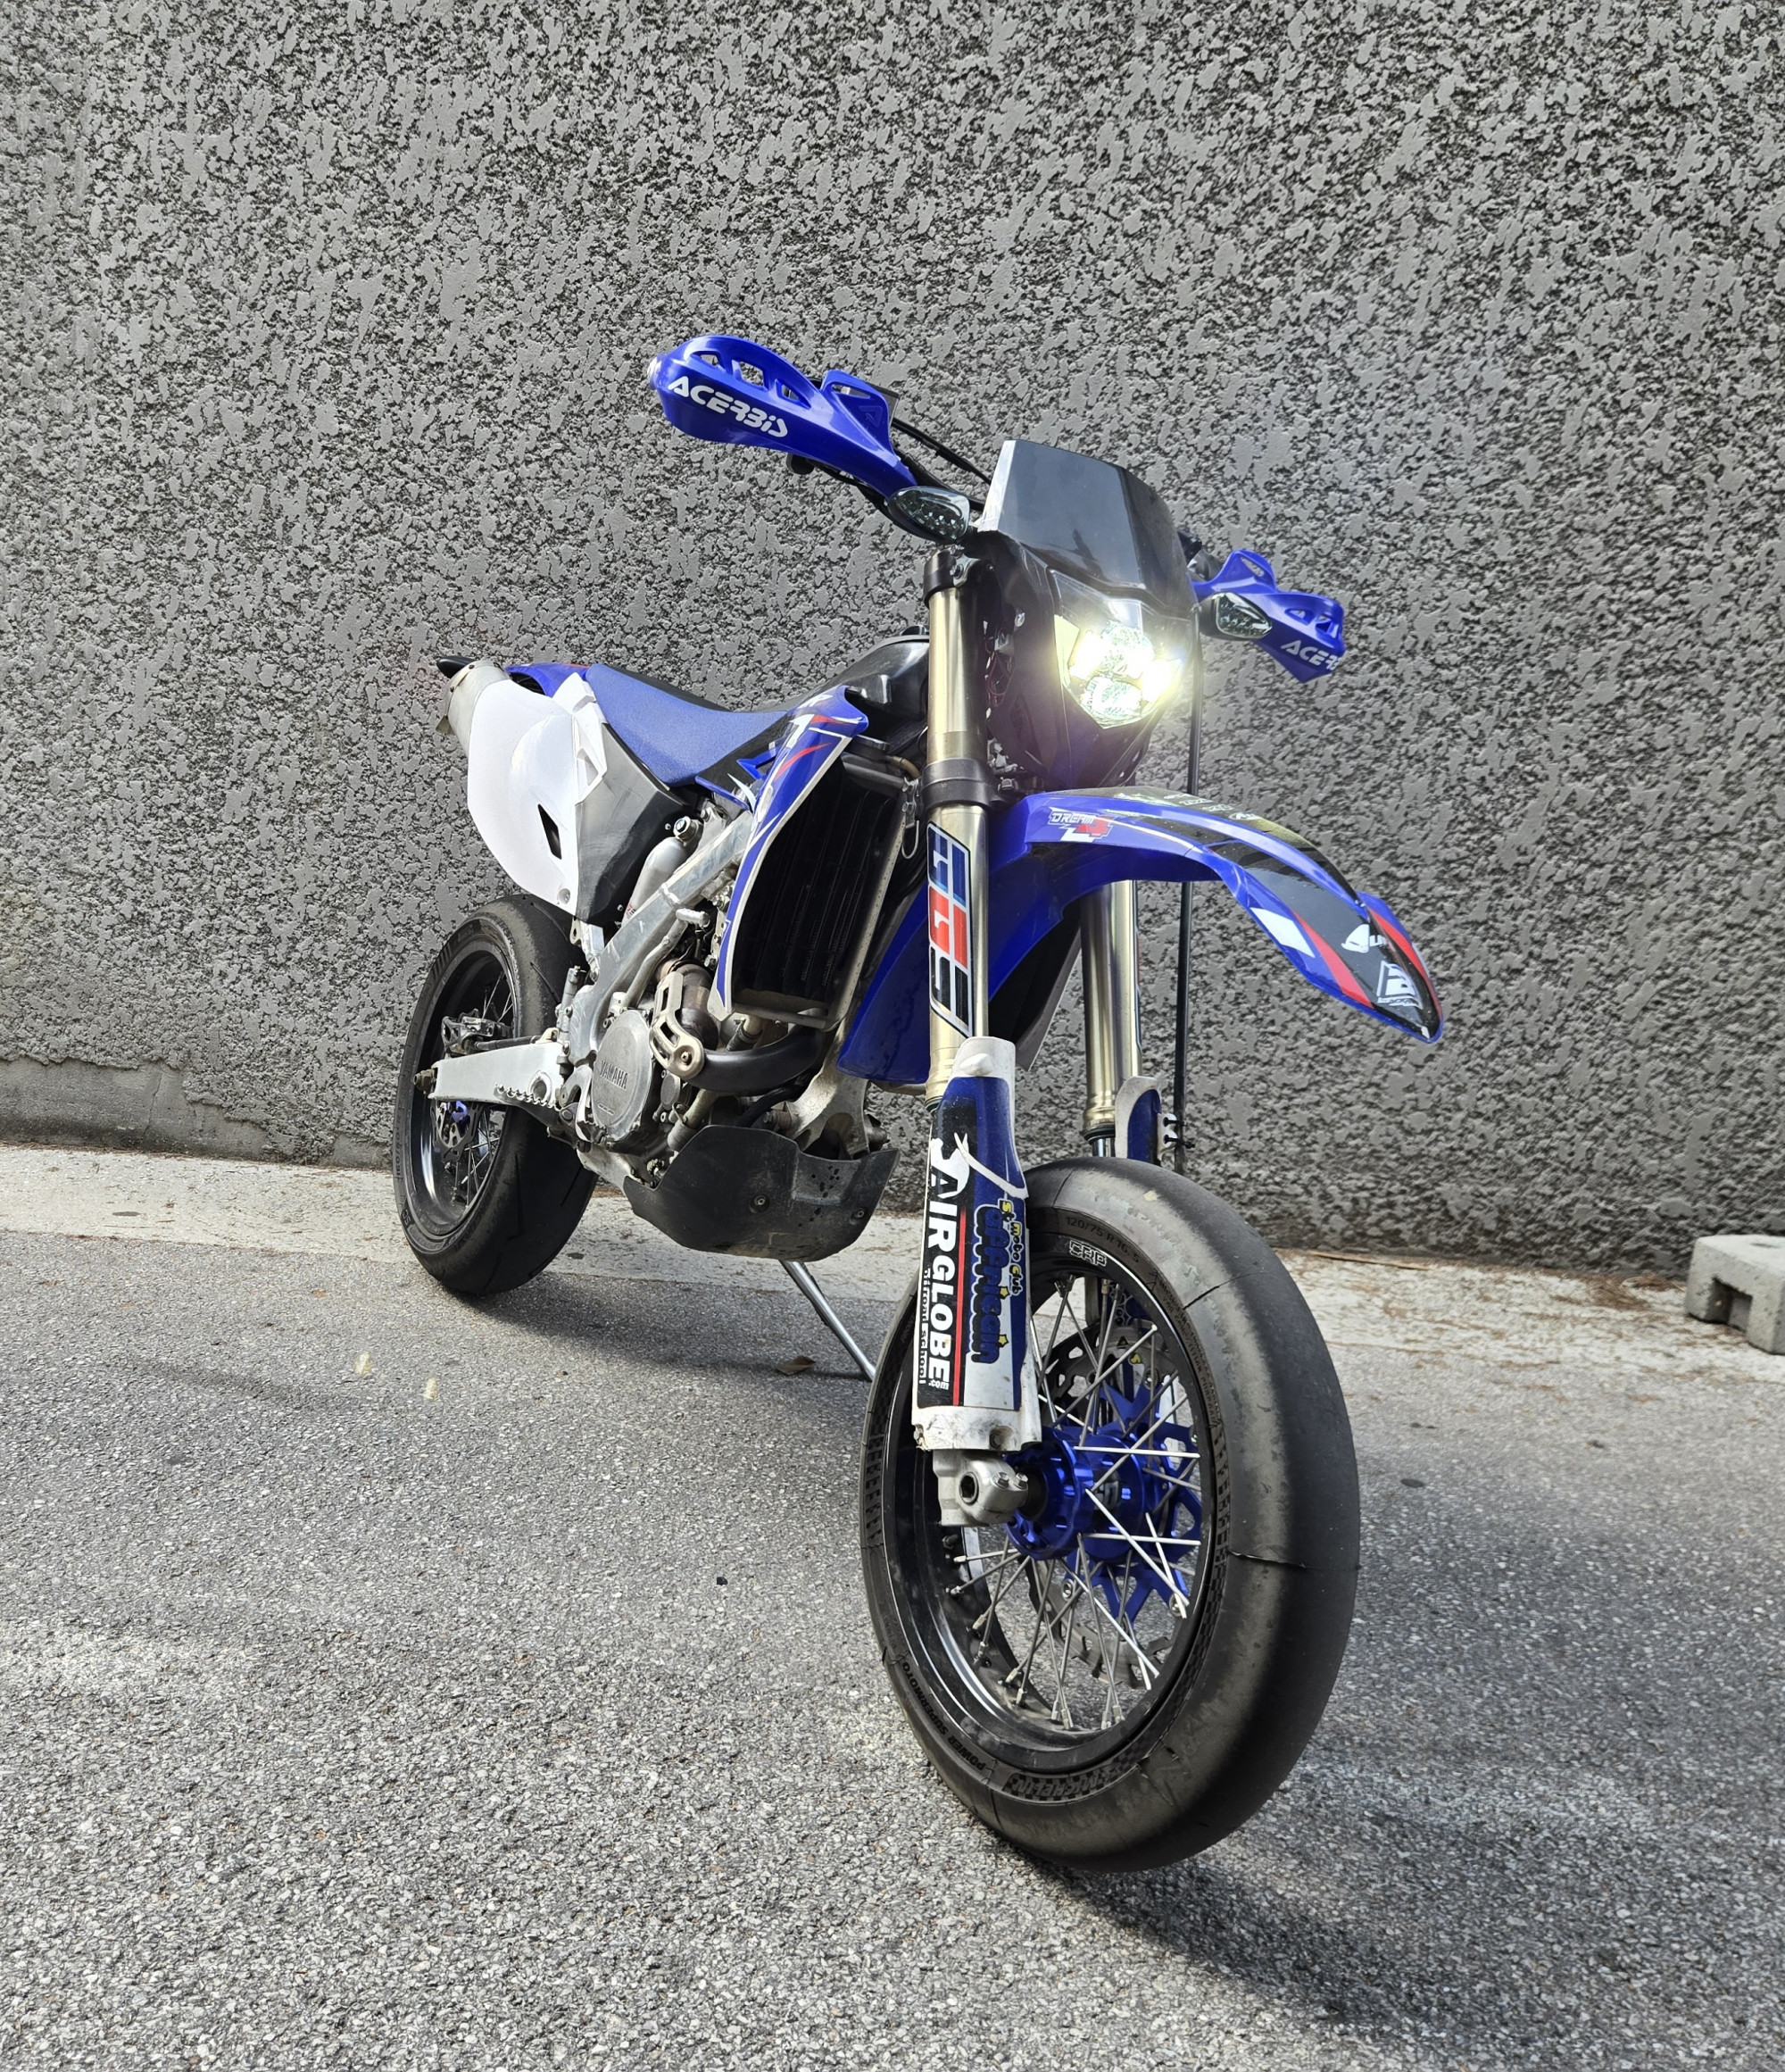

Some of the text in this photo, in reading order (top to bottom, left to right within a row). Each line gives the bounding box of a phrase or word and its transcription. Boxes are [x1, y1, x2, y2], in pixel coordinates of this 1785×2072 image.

[1050, 811, 1097, 825] DREAM
[599, 1061, 627, 1090] YAMAHA
[1066, 1217, 1103, 1236] 120/75
[1107, 1234, 1115, 1244] R
[902, 1661, 986, 1770] POWER SUPERMOTO
